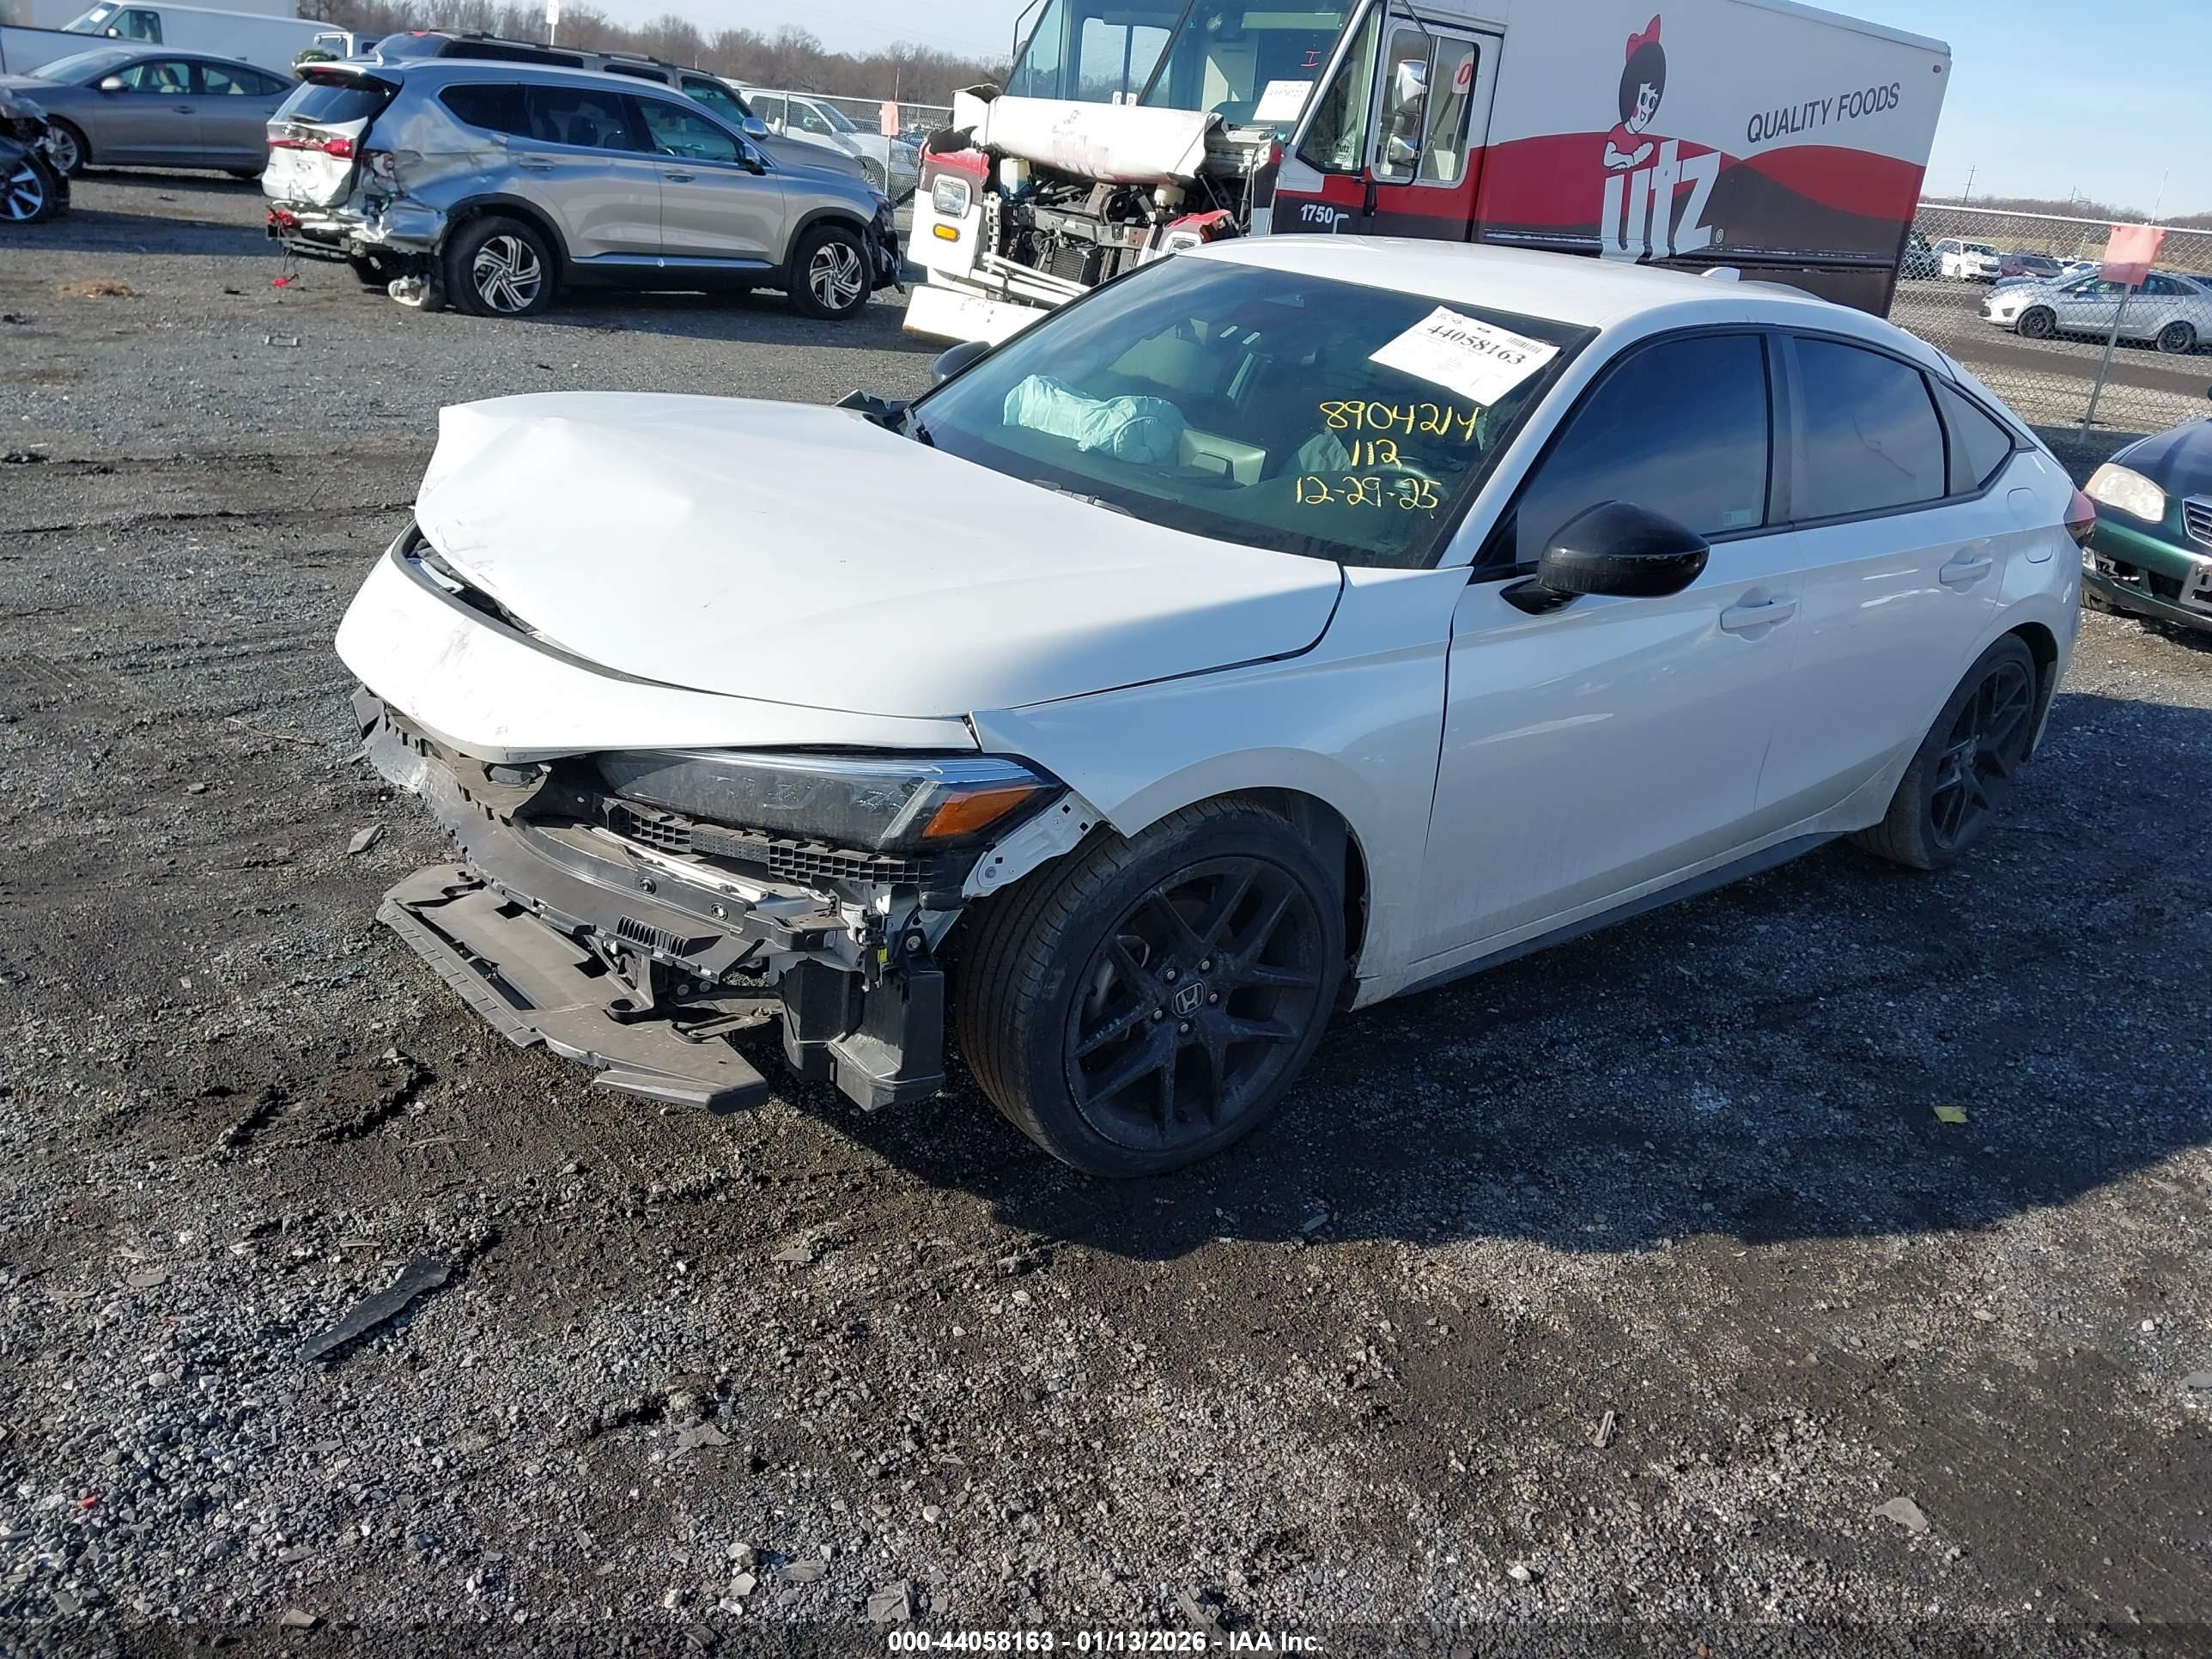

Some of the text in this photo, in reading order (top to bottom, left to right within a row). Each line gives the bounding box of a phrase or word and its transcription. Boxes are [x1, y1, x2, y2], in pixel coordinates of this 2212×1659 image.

[1747, 82, 1901, 143] QUALITY FOODS
[1300, 203, 1334, 224] 1750
[1426, 325, 1527, 365] 44058163
[1351, 439, 1401, 469] 112
[1296, 477, 1442, 510] 12-29-25
